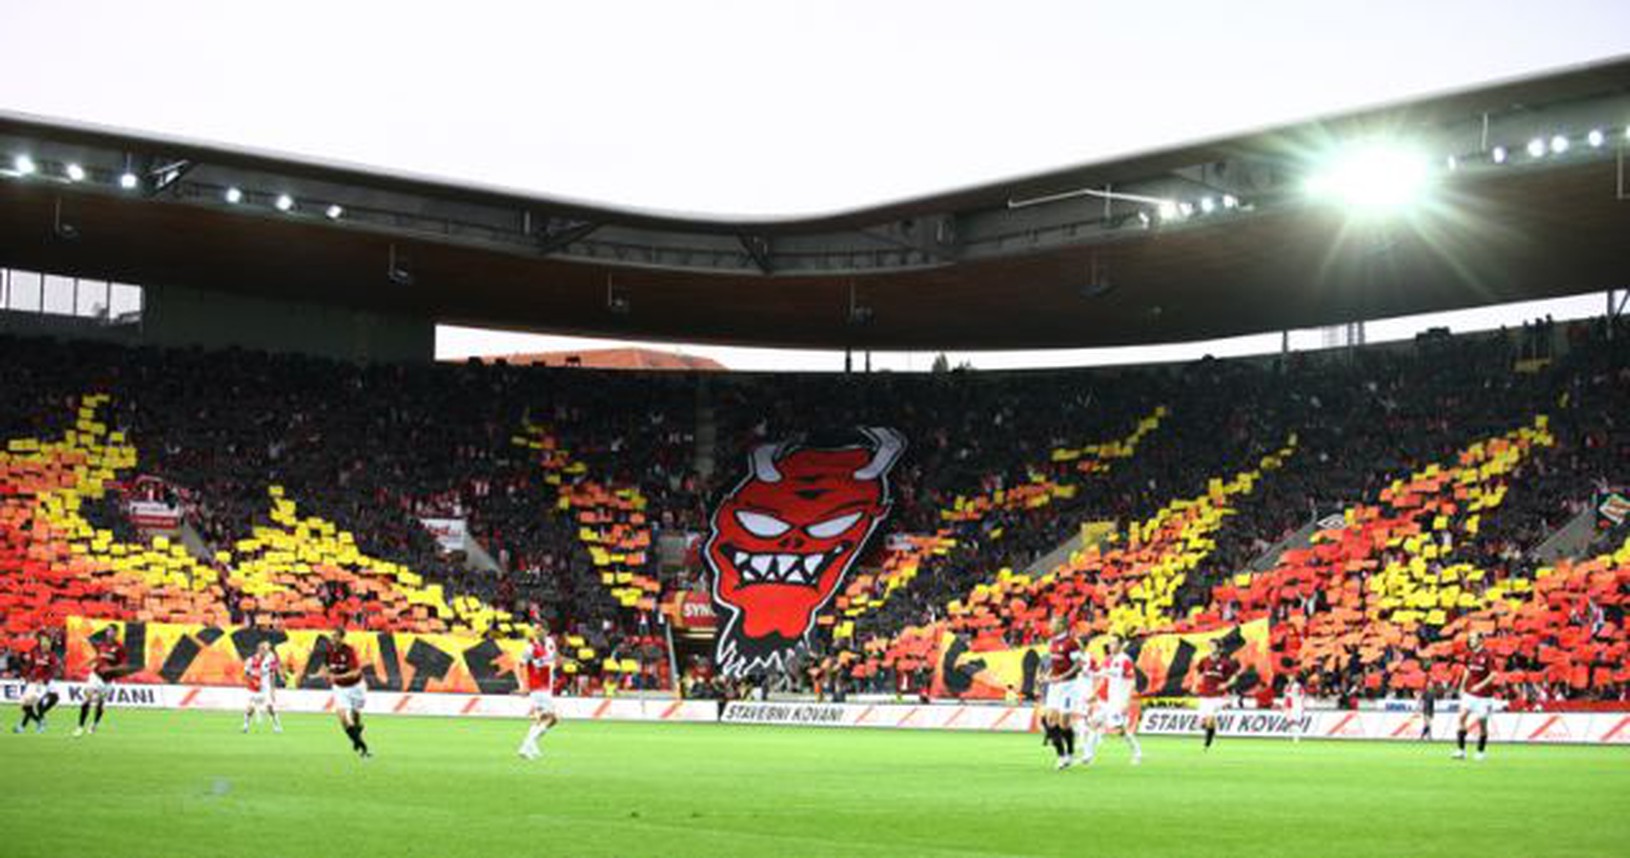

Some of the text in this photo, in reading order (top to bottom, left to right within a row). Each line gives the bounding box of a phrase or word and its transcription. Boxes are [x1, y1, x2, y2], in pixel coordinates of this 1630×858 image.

[68, 685, 155, 704] KVANI
[1146, 712, 1312, 733] STAVENI KOVAI
